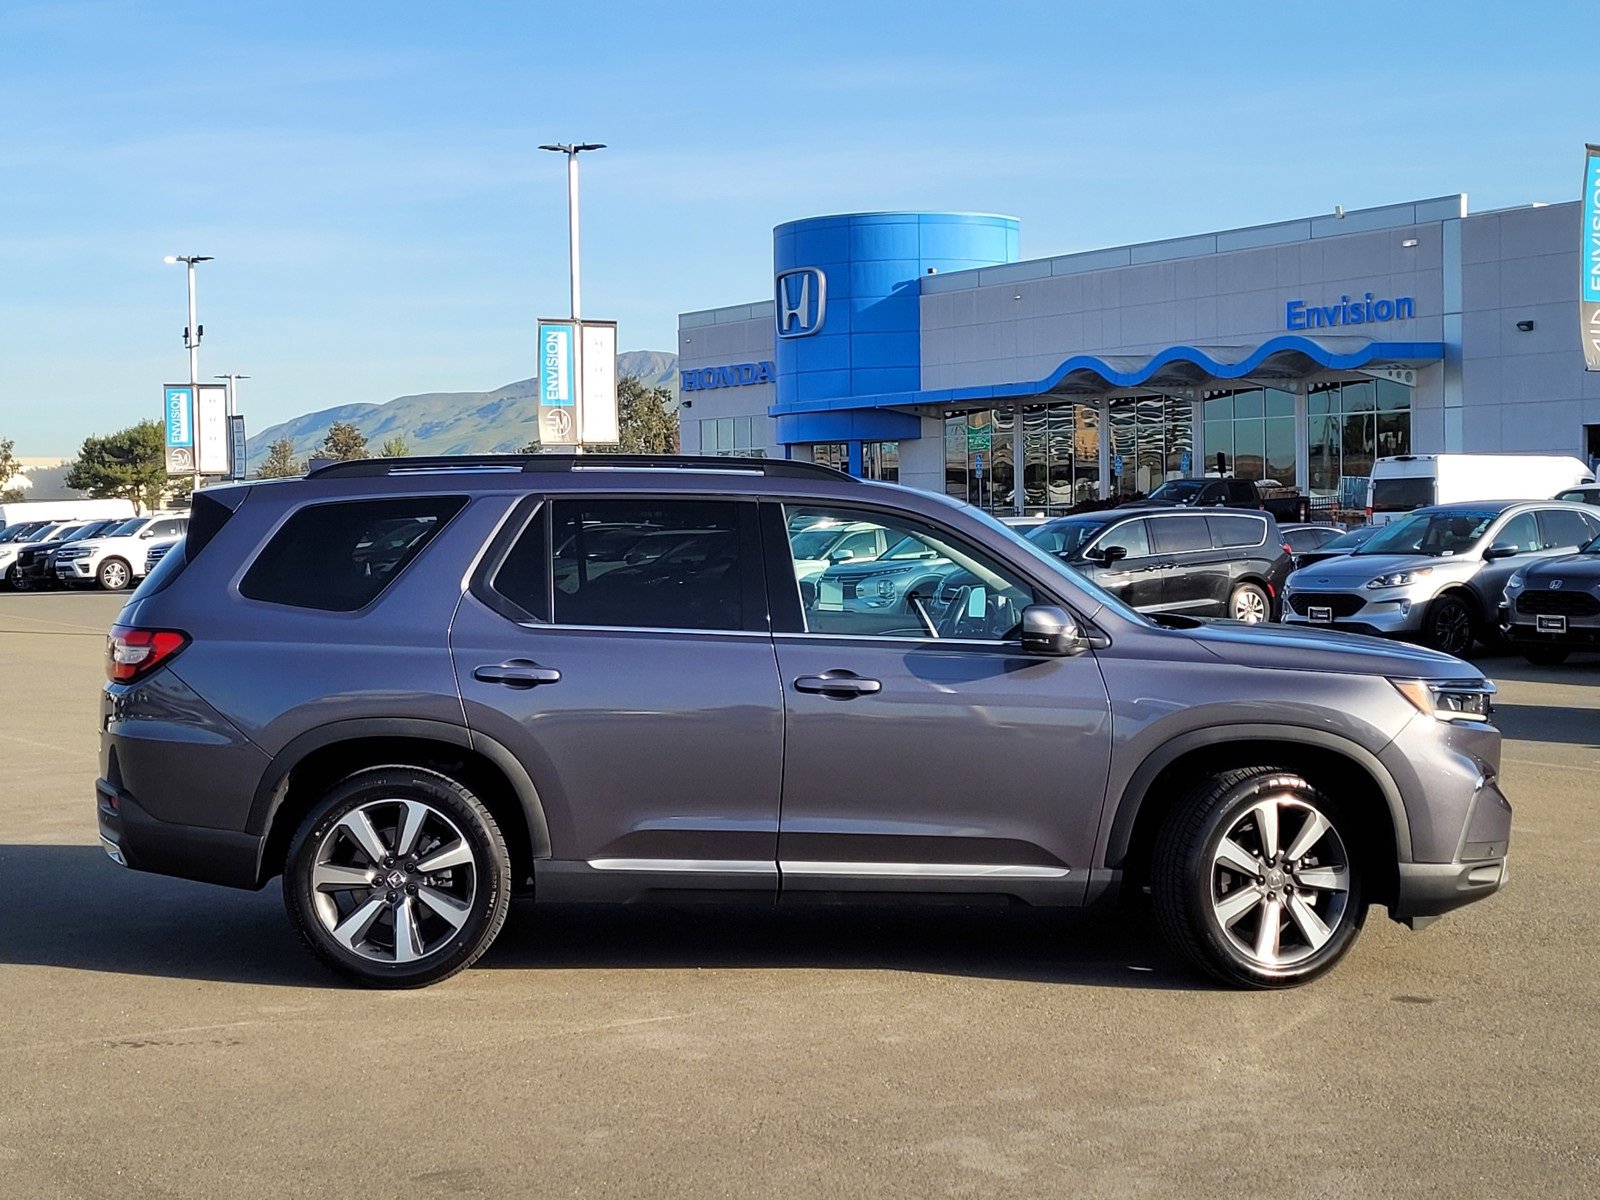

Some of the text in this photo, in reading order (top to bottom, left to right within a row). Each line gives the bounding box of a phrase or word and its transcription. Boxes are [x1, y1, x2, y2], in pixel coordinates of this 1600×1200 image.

[1591, 168, 1600, 291] ENVISIO
[1286, 292, 1416, 330] Envision
[546, 331, 559, 400] ENVISION
[680, 361, 776, 391] HONDA
[171, 392, 181, 443] ENVISION
